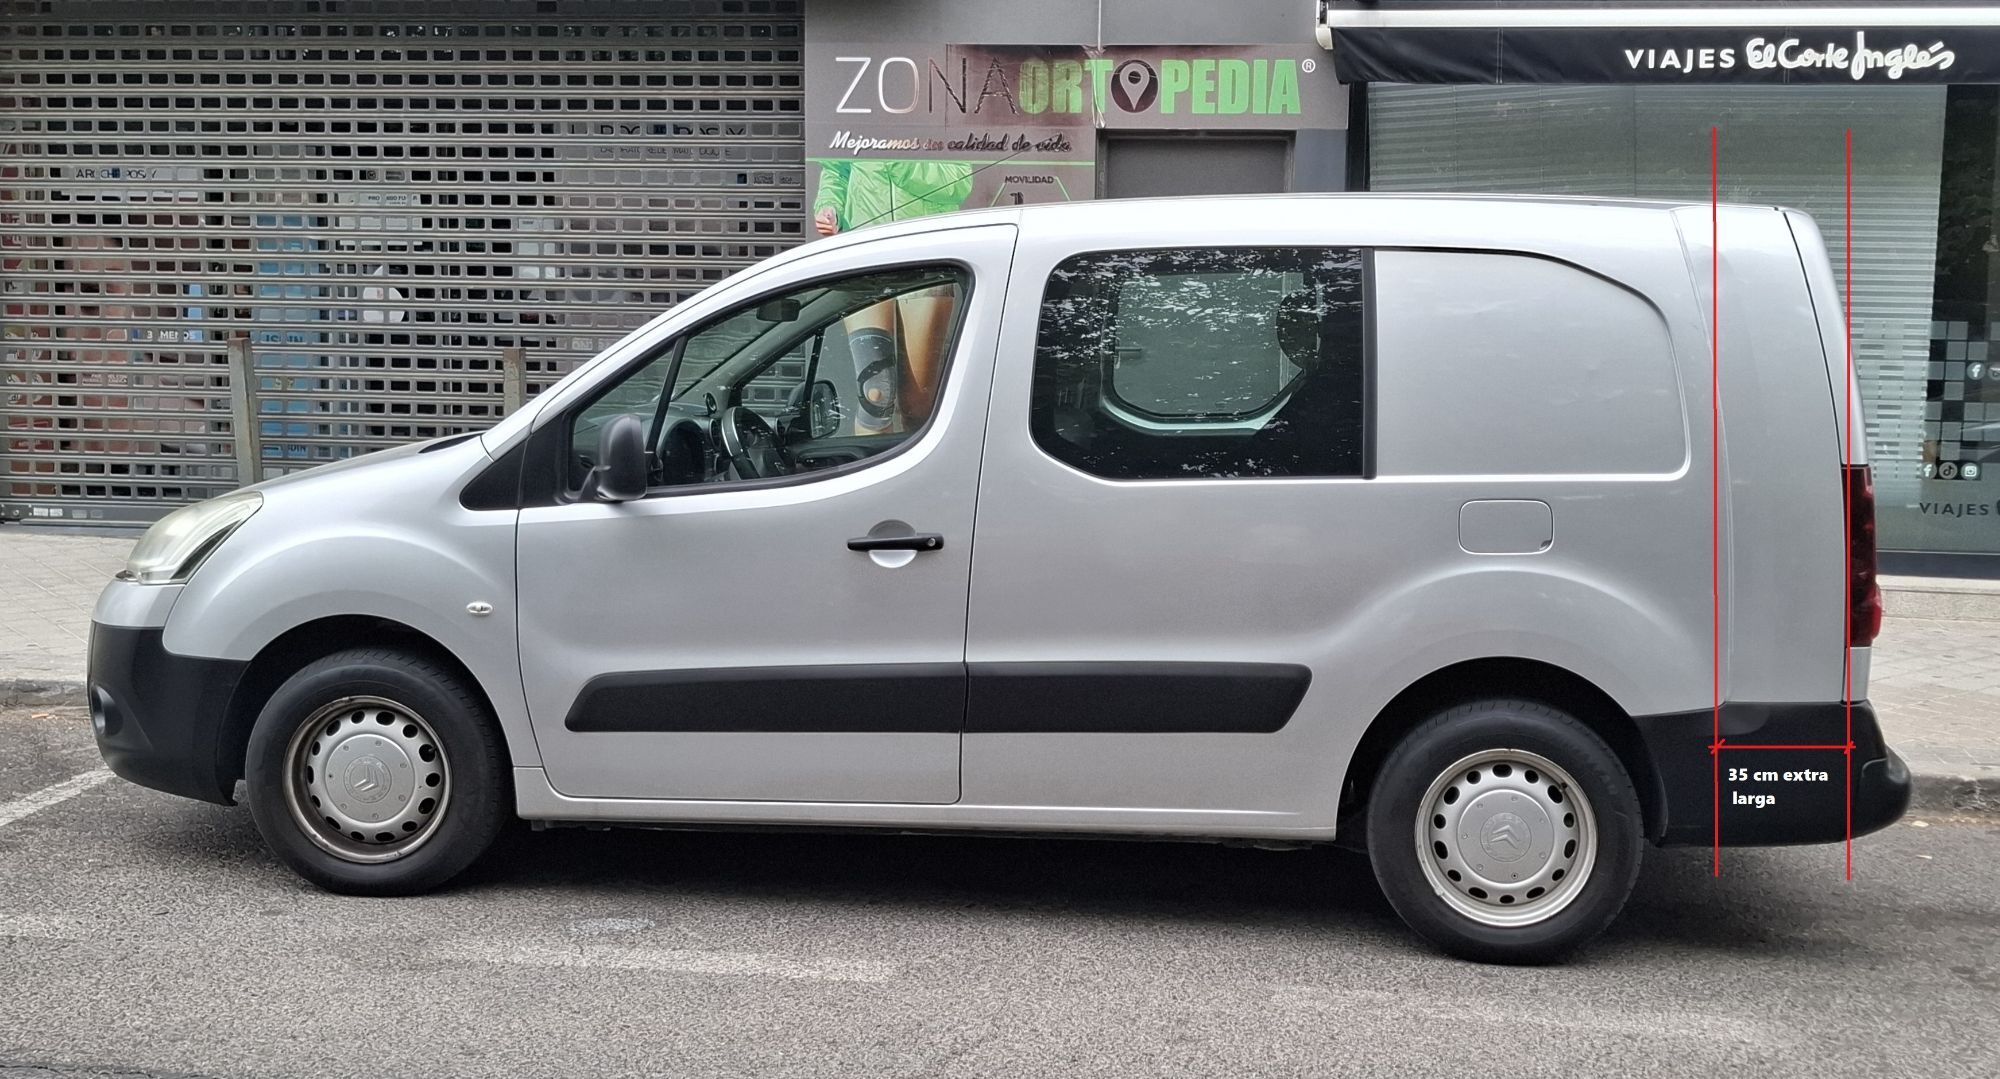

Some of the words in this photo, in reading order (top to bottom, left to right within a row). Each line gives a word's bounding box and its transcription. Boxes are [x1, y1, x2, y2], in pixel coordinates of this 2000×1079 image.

[1624, 48, 1735, 73] VIAJES
[1777, 38, 1848, 69] Corte
[1850, 30, 1955, 81] Inglés
[829, 130, 920, 156] Mejoramos
[947, 132, 1008, 152] calidad
[1004, 175, 1055, 184] MOVILIDAD
[1919, 502, 1990, 518] VIAJES
